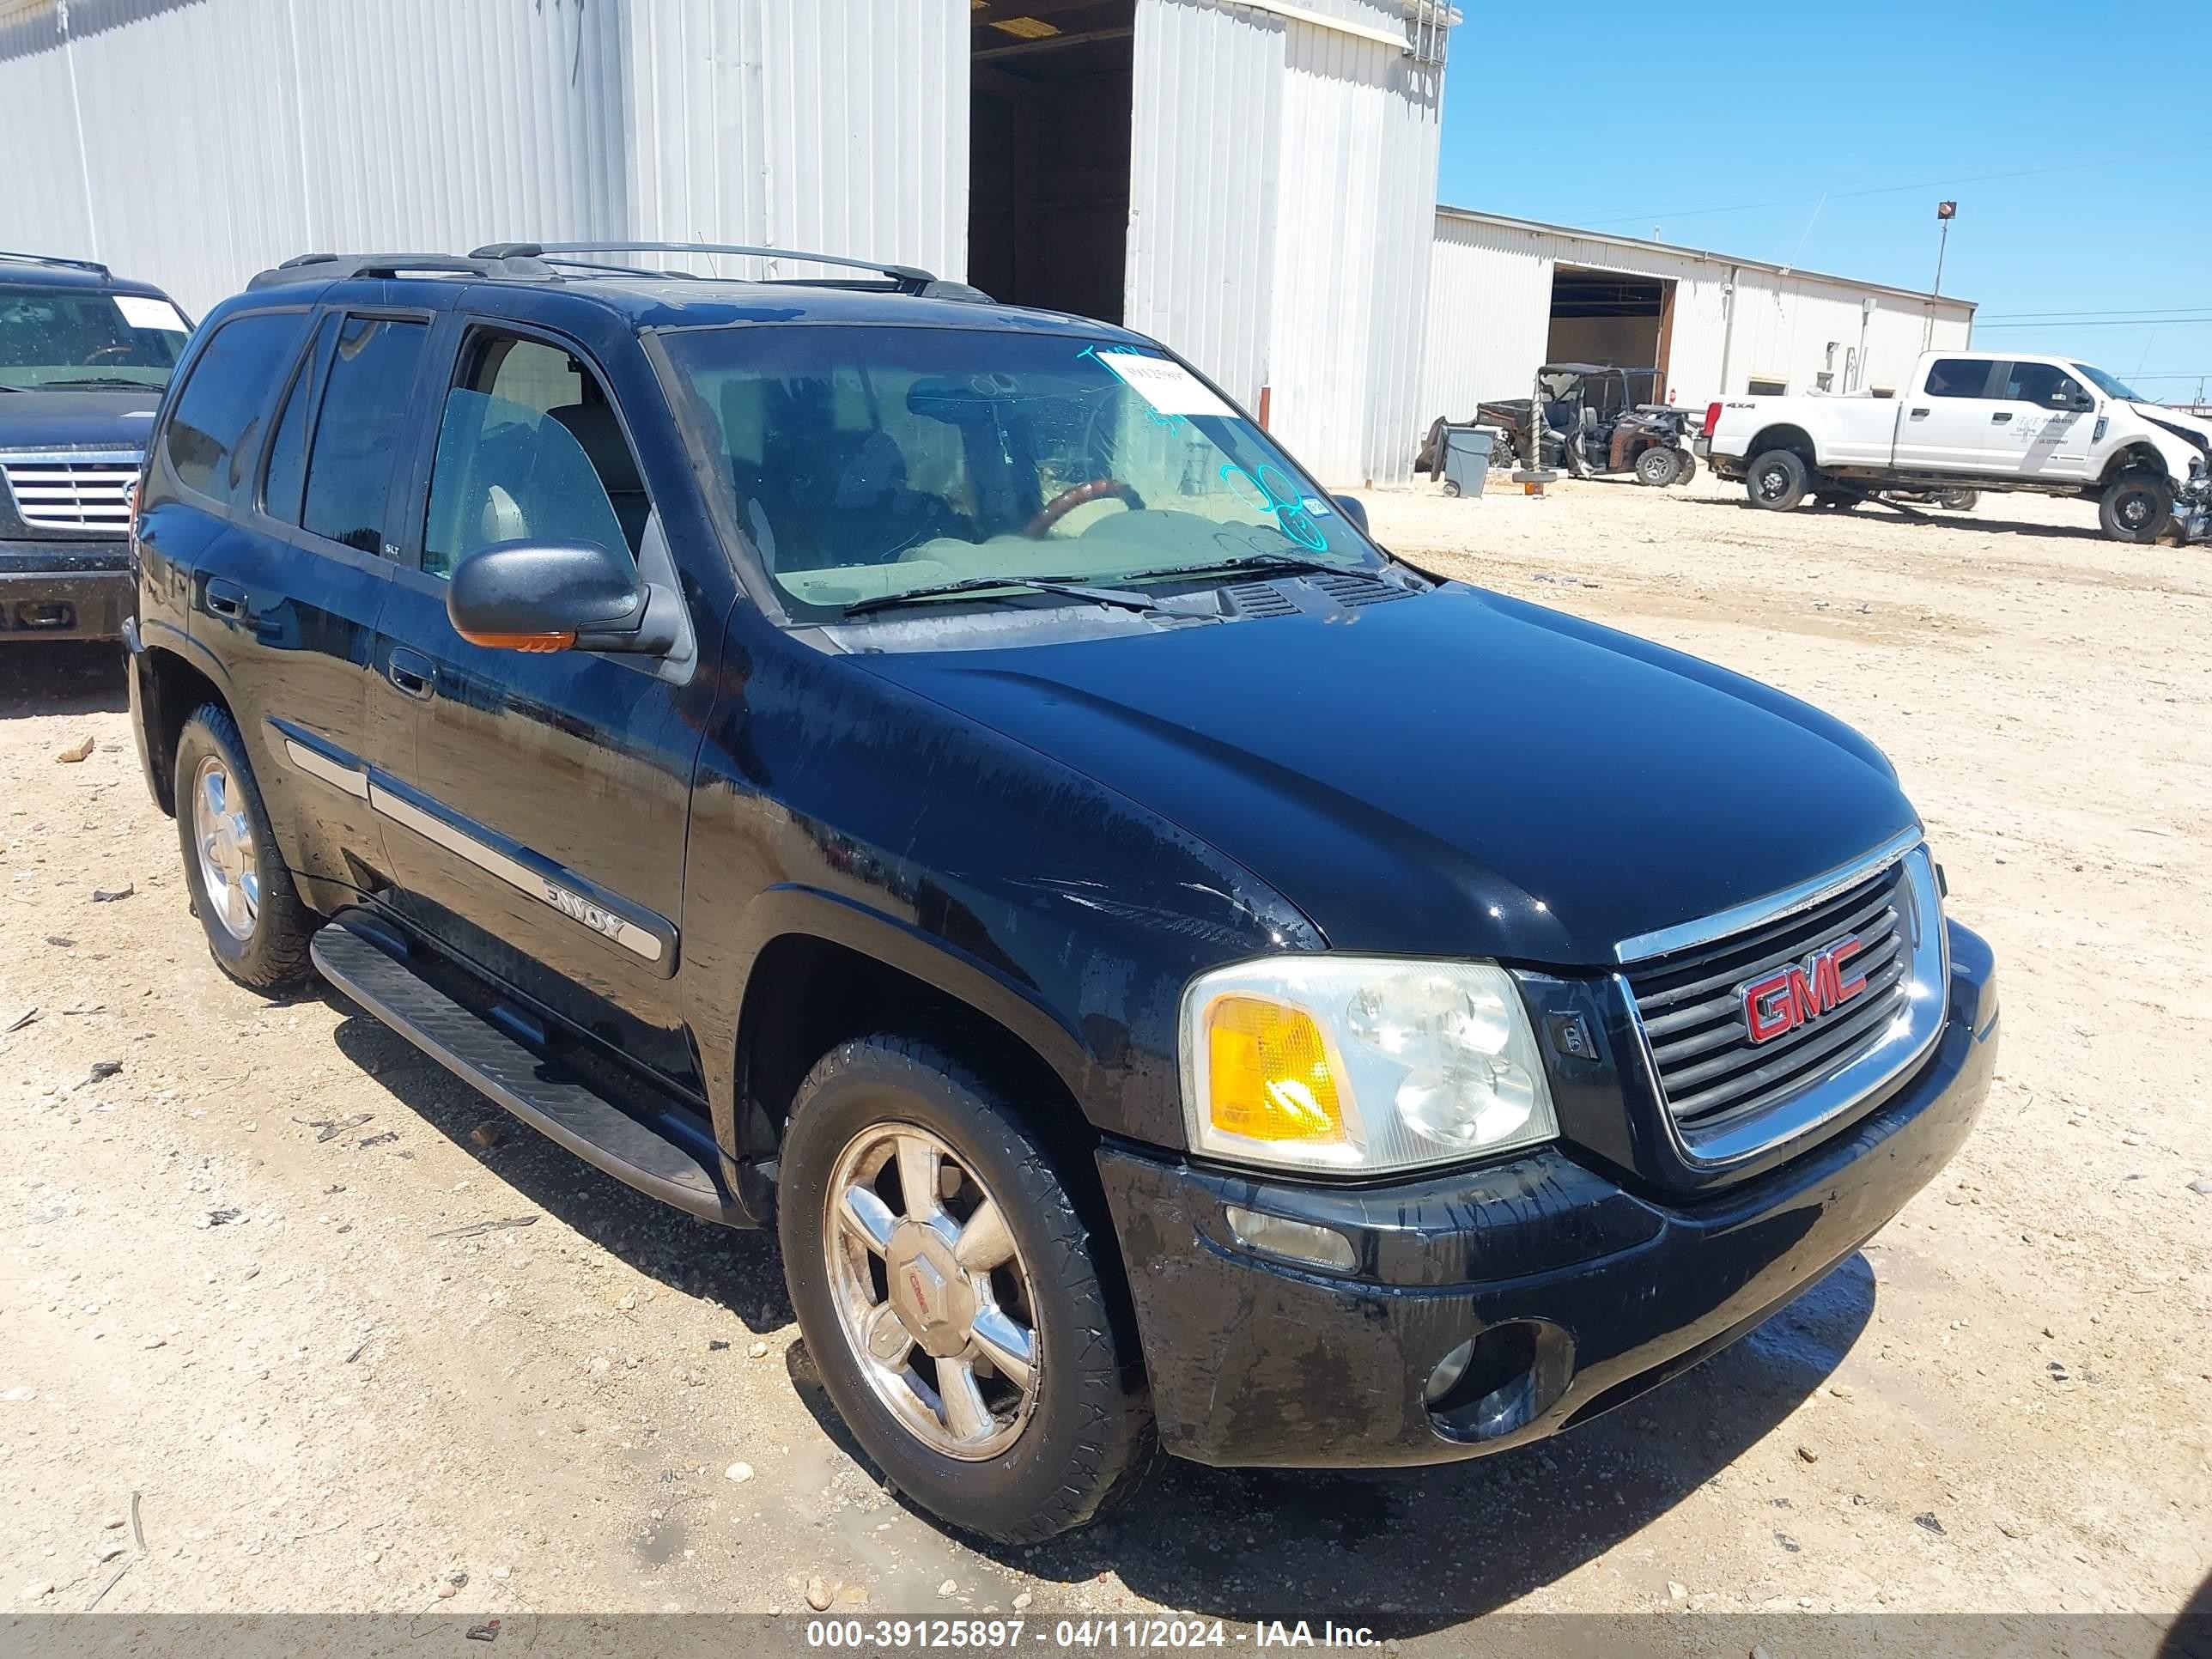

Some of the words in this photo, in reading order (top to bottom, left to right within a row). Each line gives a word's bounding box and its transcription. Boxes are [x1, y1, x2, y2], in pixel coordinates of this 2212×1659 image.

[385, 544, 400, 556] SLT
[543, 879, 626, 940] ENVOY
[1738, 933, 1868, 1044] GMC
